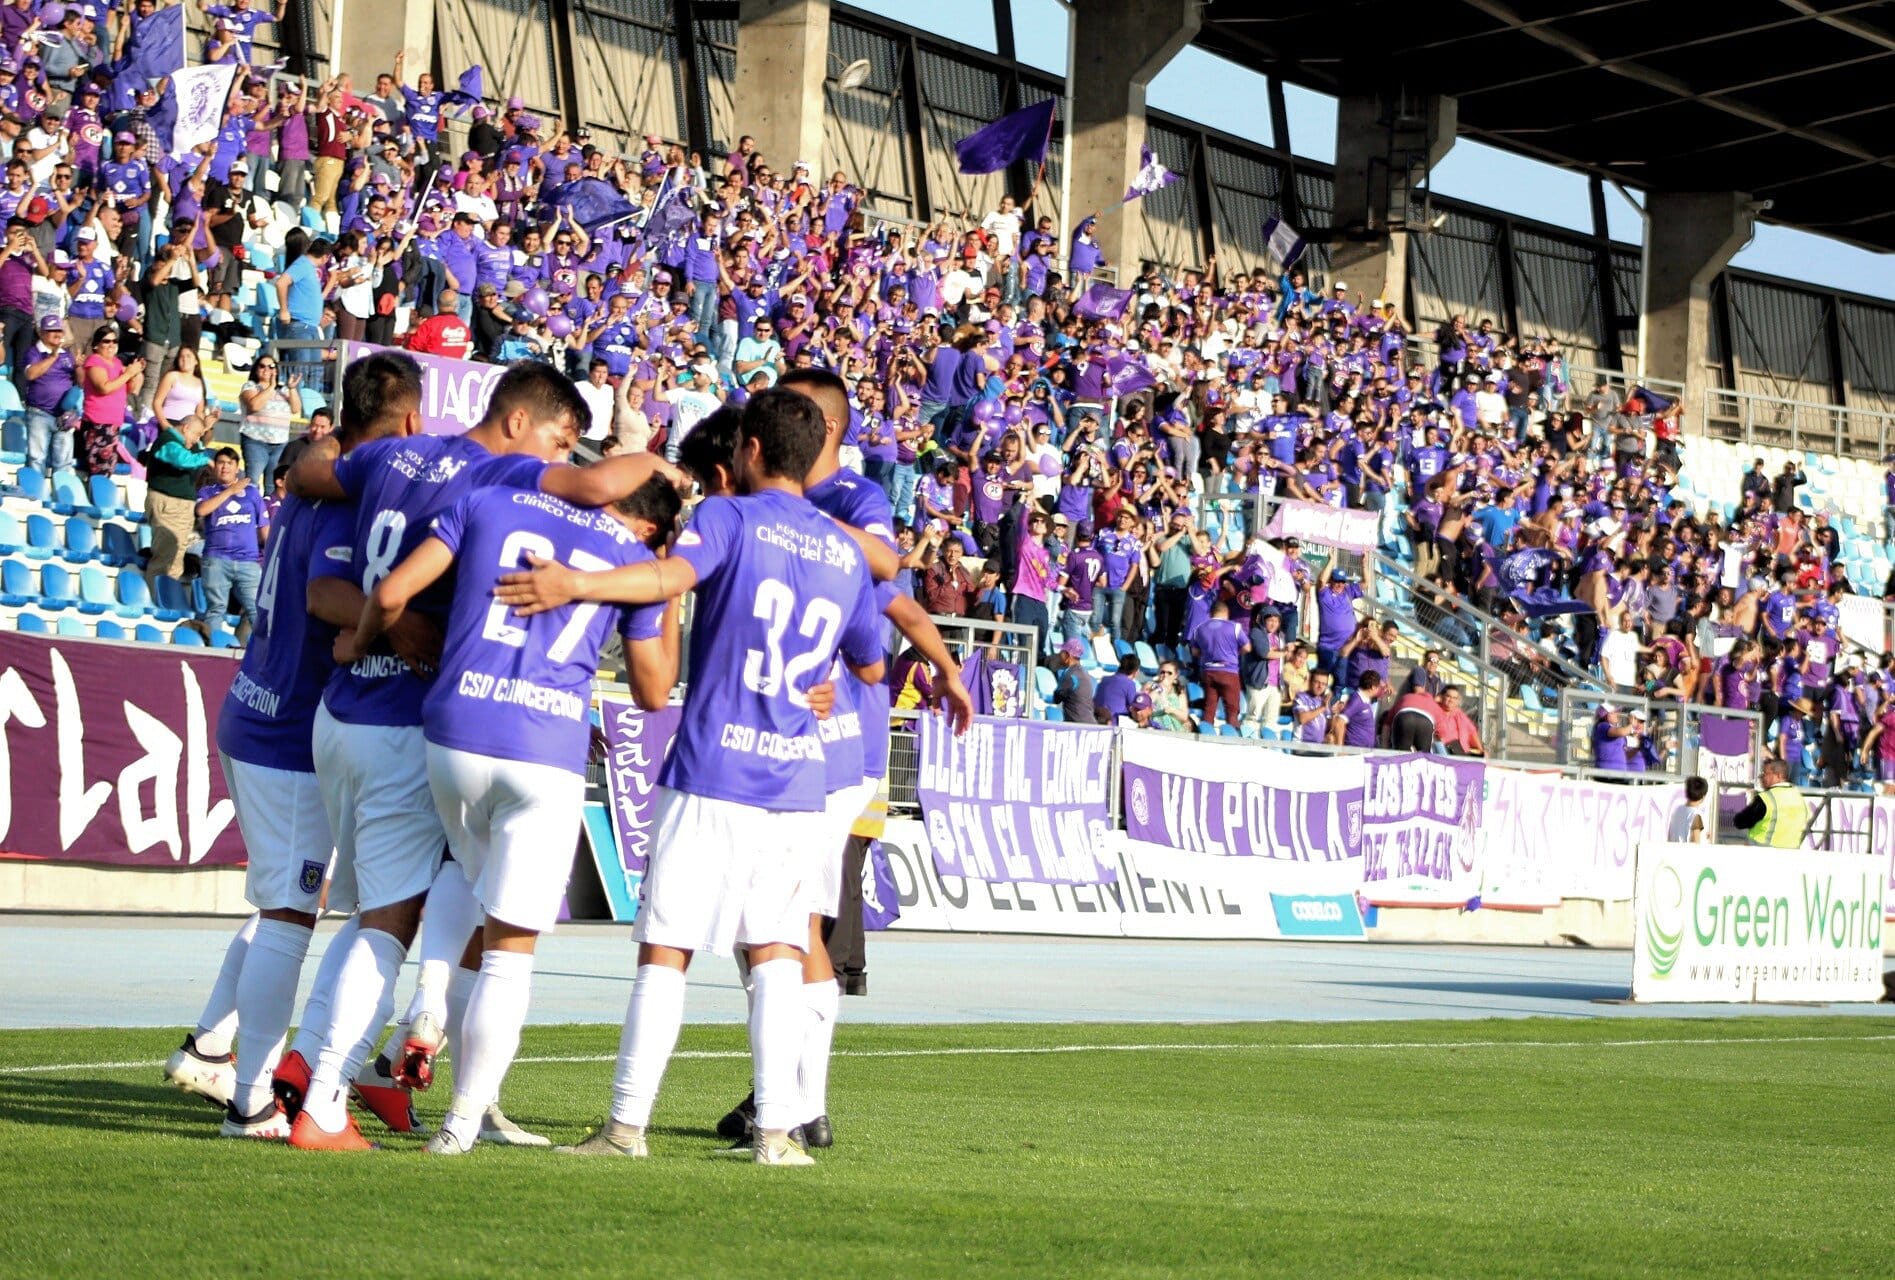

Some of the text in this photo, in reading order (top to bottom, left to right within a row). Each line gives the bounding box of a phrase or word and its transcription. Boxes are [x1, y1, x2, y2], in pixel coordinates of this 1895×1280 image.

[420, 363, 508, 429] IAGO
[363, 509, 407, 600] 8
[566, 510, 592, 529] del
[594, 518, 617, 538] Sur
[800, 543, 820, 562] del
[482, 530, 616, 664] 27
[743, 578, 842, 710] 32
[459, 670, 495, 699] CSD
[721, 723, 755, 752] CSD
[920, 711, 994, 800] LLEVO
[1161, 773, 1349, 863] VALPOLILA
[1363, 757, 1457, 819] LOS REYES
[1363, 832, 1388, 882] DEL
[1693, 866, 1883, 950] Green World
[1689, 955, 1880, 989] www.greenworldchile.cl
